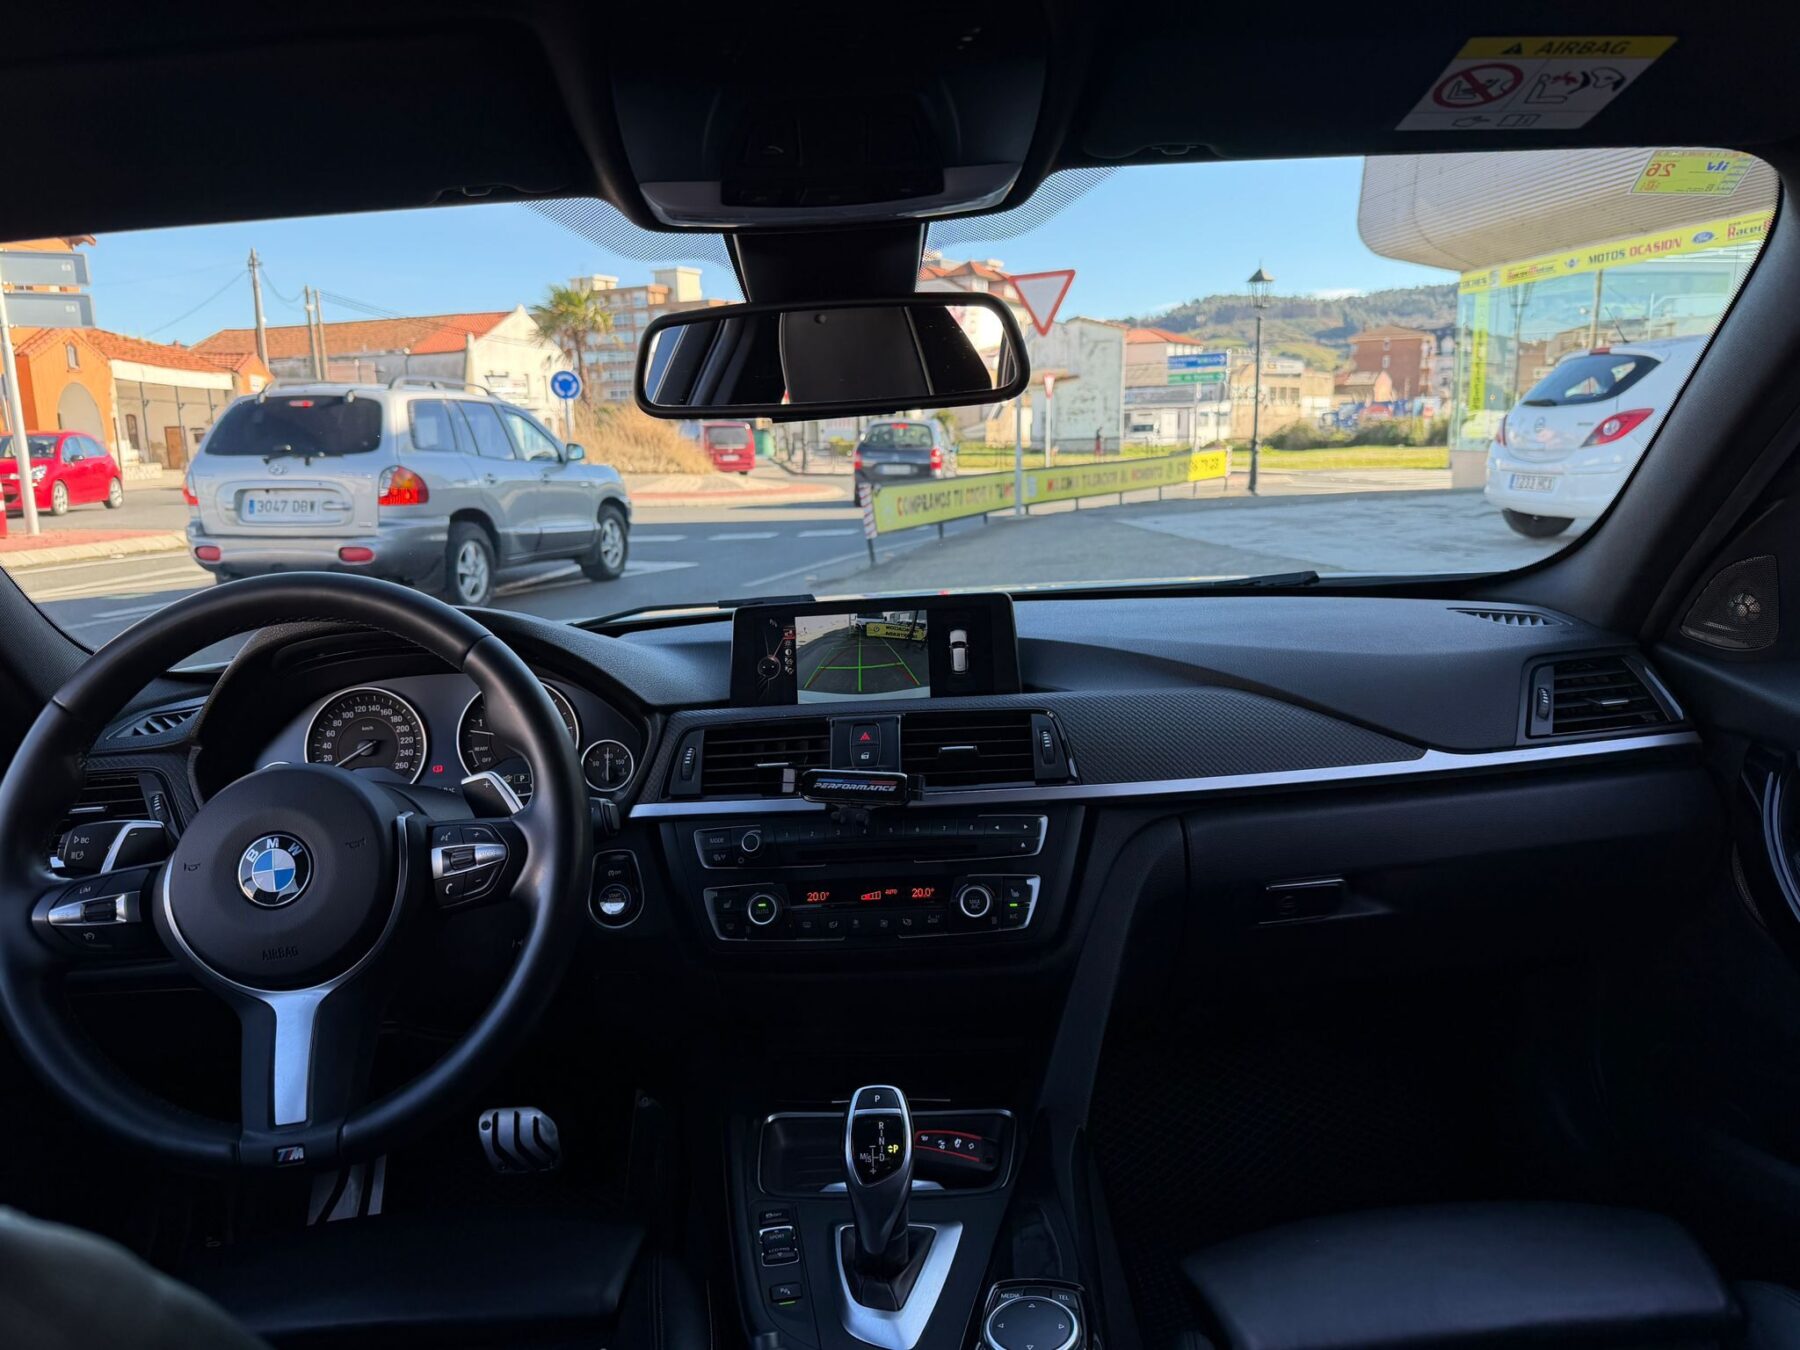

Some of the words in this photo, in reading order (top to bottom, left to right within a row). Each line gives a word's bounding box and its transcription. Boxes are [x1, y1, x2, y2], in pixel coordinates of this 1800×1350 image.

[1534, 41, 1631, 55] AIRBAG
[1588, 249, 1626, 264] MOTOS
[1629, 238, 1682, 257] OCASION
[257, 500, 288, 513] 3047
[354, 705, 367, 713] 120
[368, 704, 380, 712] 140
[380, 708, 393, 716] 160
[342, 711, 354, 719] 100
[390, 715, 403, 723] 180
[332, 719, 342, 727] 80
[479, 718, 483, 727] 1
[395, 725, 409, 733] 200
[400, 736, 413, 744] 220
[322, 742, 332, 750] 40
[399, 749, 413, 757] 240
[394, 761, 409, 770] 260
[813, 782, 897, 792] PERFORMANCE
[246, 837, 303, 862] BMW
[79, 886, 92, 894] LIM
[262, 946, 299, 961] AIRBAG
[874, 1094, 880, 1103] P
[878, 1121, 884, 1130] R
[879, 1137, 885, 1145] N
[879, 1153, 885, 1162] D
